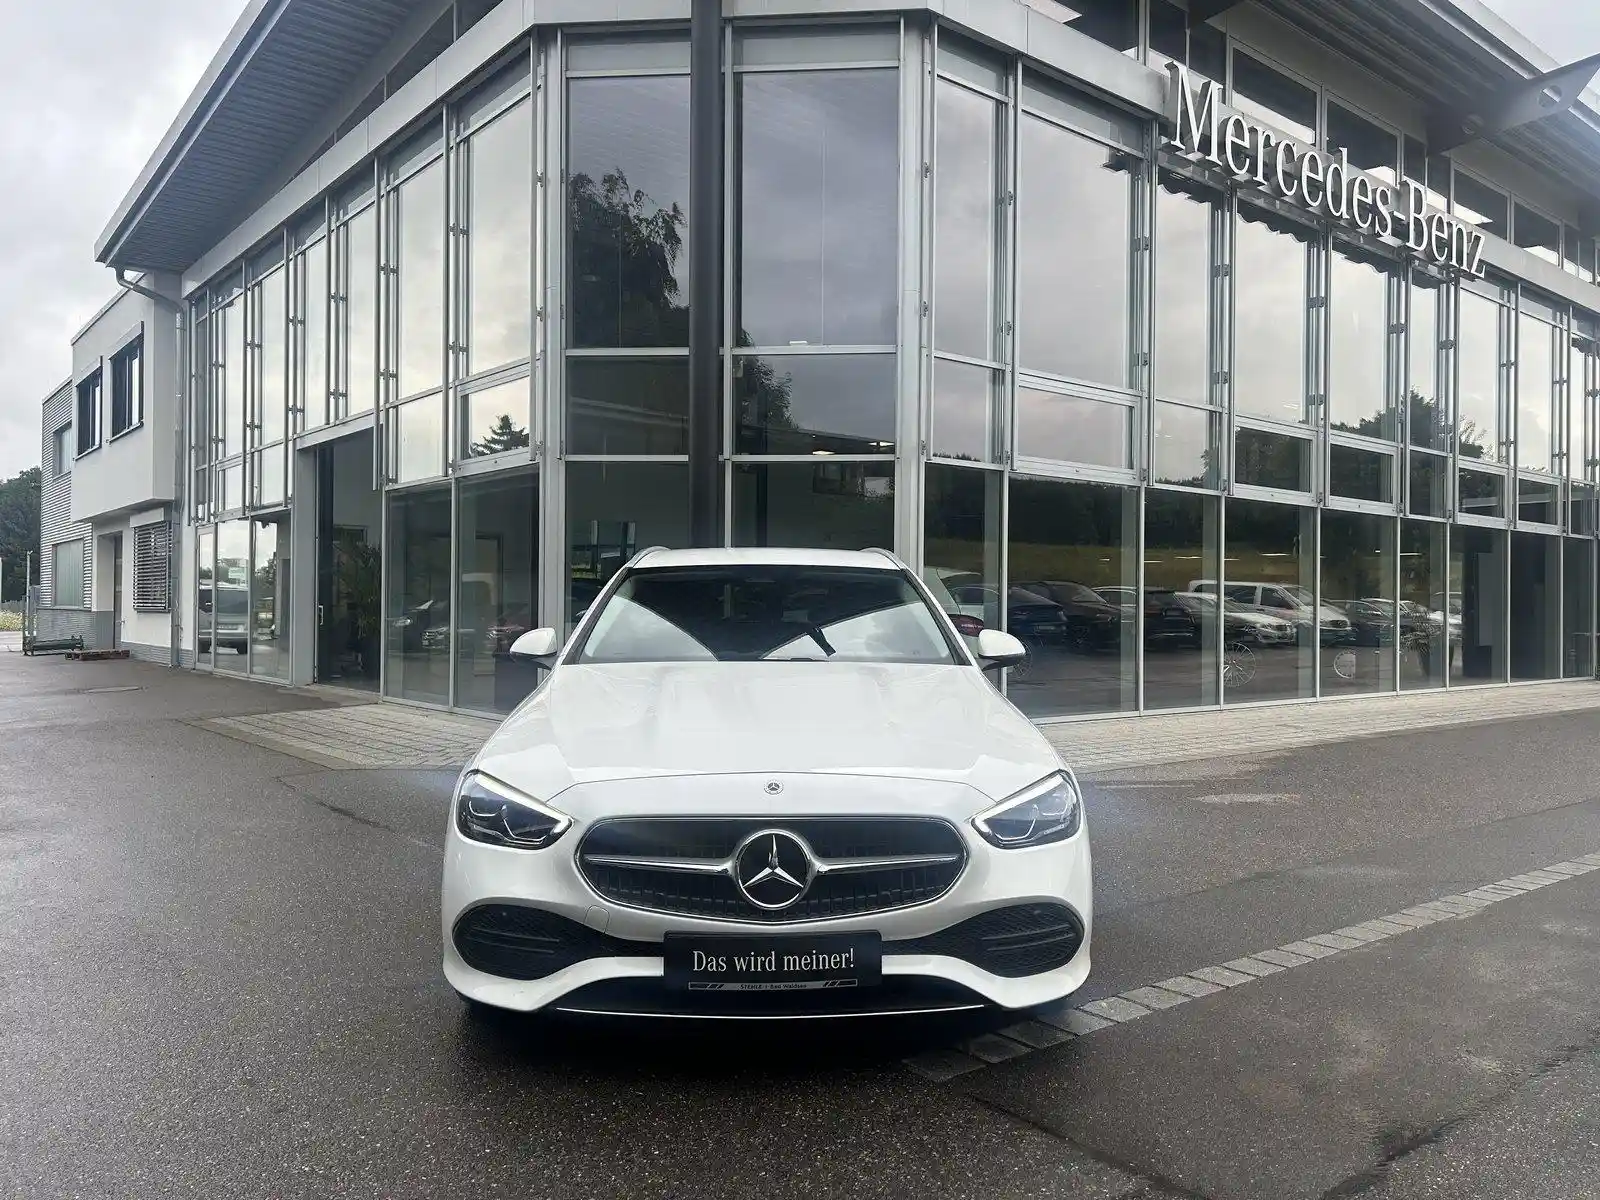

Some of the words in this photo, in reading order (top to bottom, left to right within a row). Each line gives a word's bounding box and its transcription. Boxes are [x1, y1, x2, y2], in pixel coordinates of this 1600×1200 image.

[1164, 60, 1486, 279] Mercedes-Benz
[692, 950, 727, 972] Das
[734, 951, 776, 971] wird
[783, 948, 855, 971] meiner!
